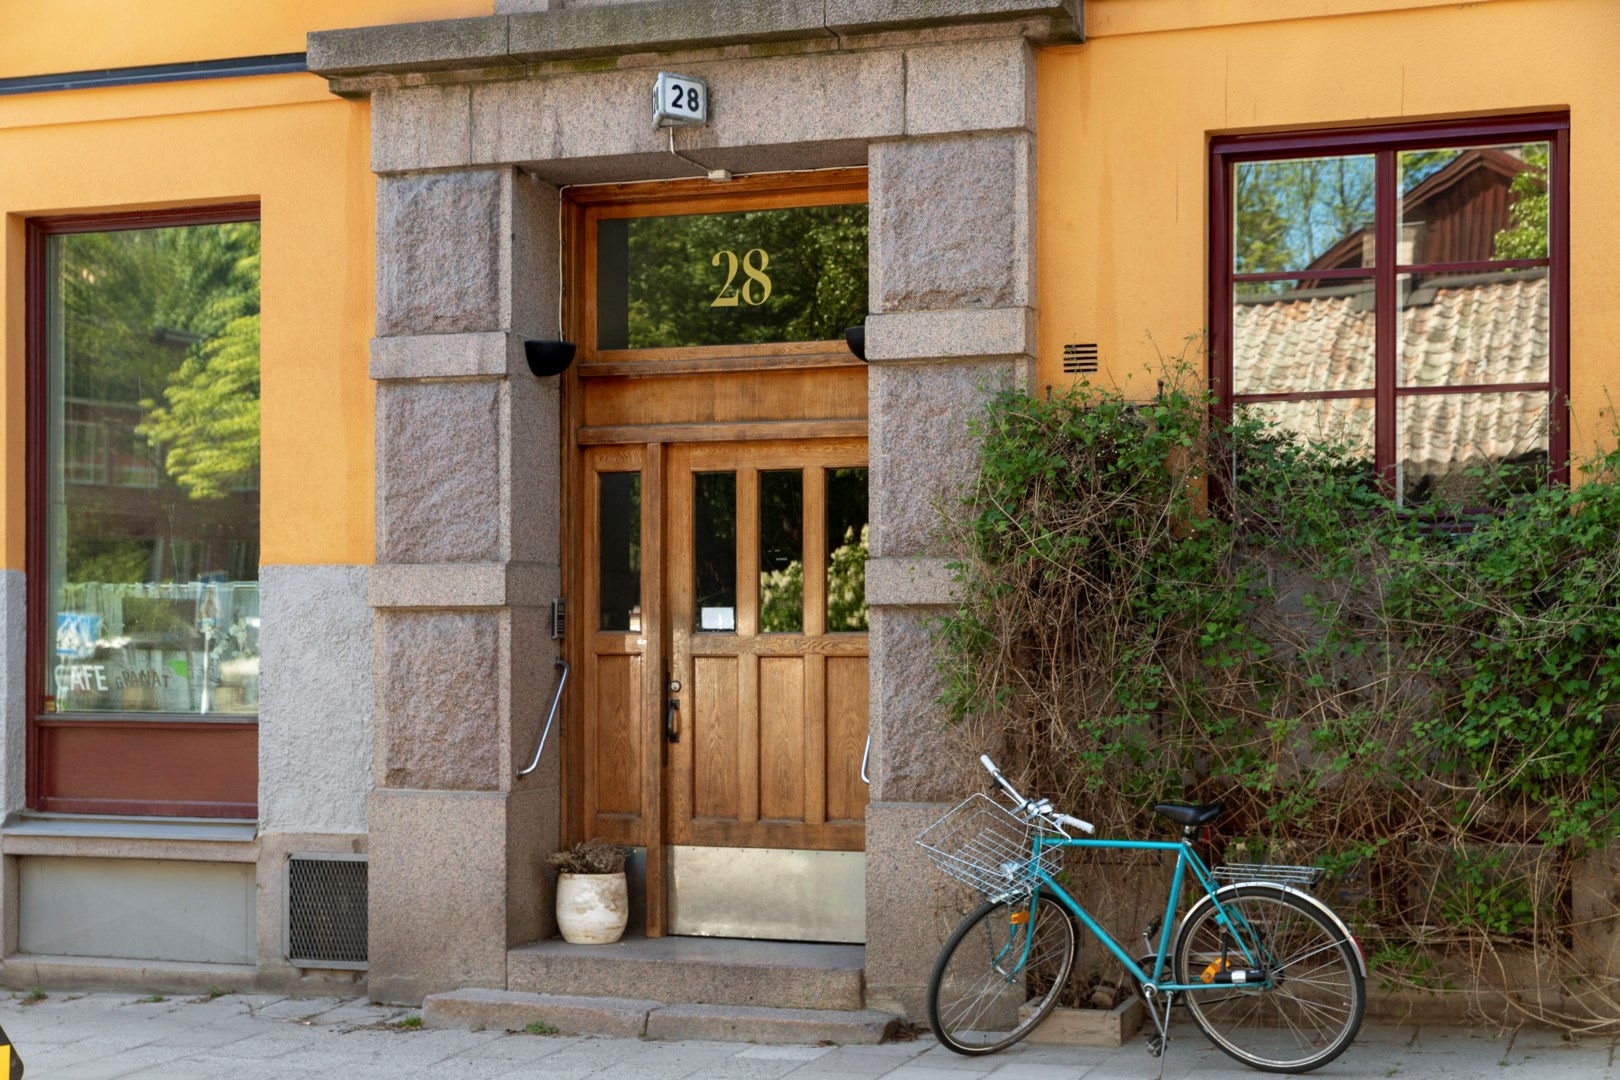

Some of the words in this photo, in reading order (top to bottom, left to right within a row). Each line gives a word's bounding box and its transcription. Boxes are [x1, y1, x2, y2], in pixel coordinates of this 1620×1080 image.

[671, 84, 699, 112] 28
[710, 248, 772, 307] 28
[54, 664, 108, 691] CAFE
